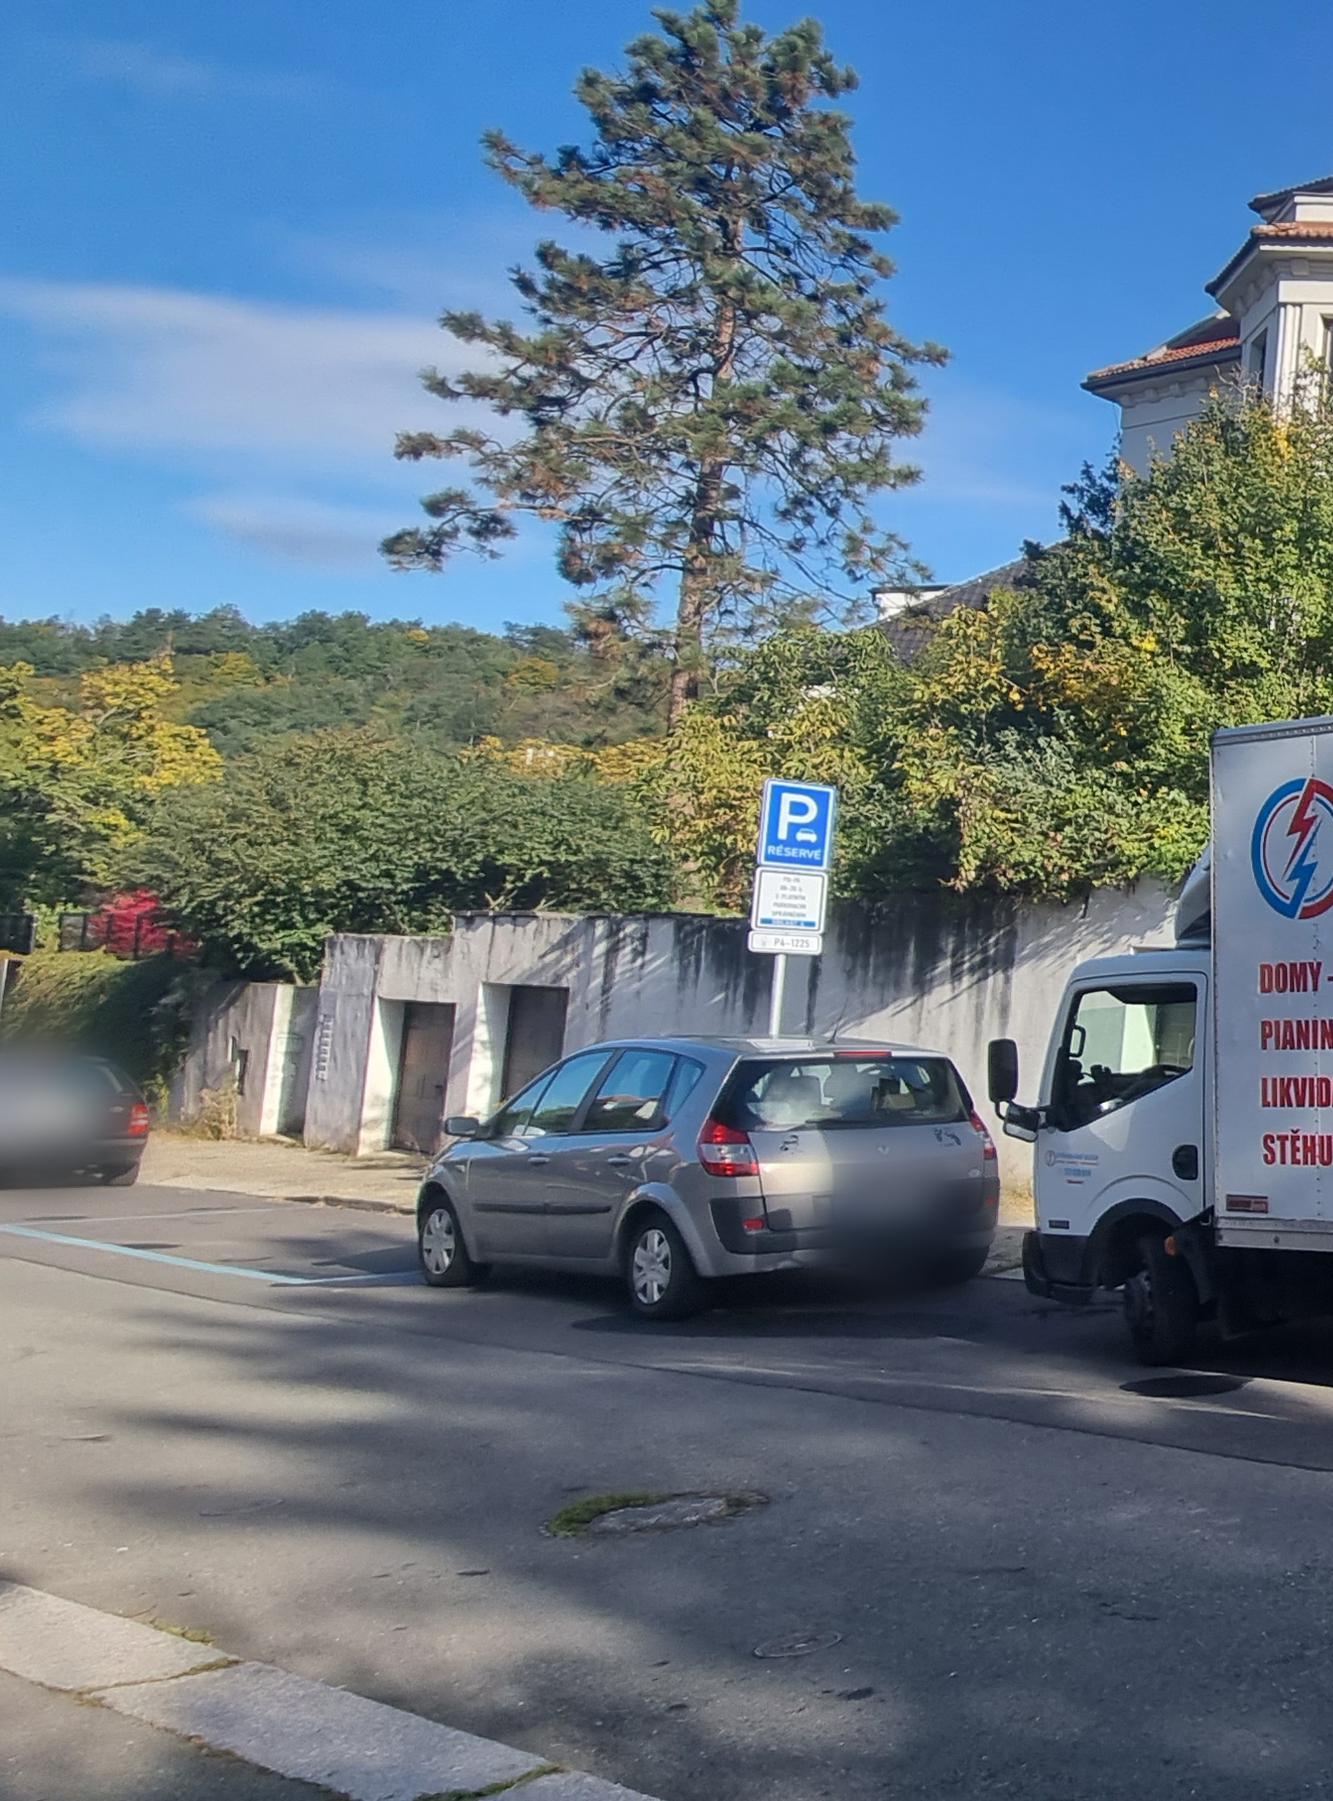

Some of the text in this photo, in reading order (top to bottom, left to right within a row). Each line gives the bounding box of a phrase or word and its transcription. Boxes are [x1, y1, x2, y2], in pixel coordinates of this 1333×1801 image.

[778, 792, 818, 841] P
[768, 844, 821, 861] RÉSERVÉ
[1260, 962, 1321, 993] DOMY
